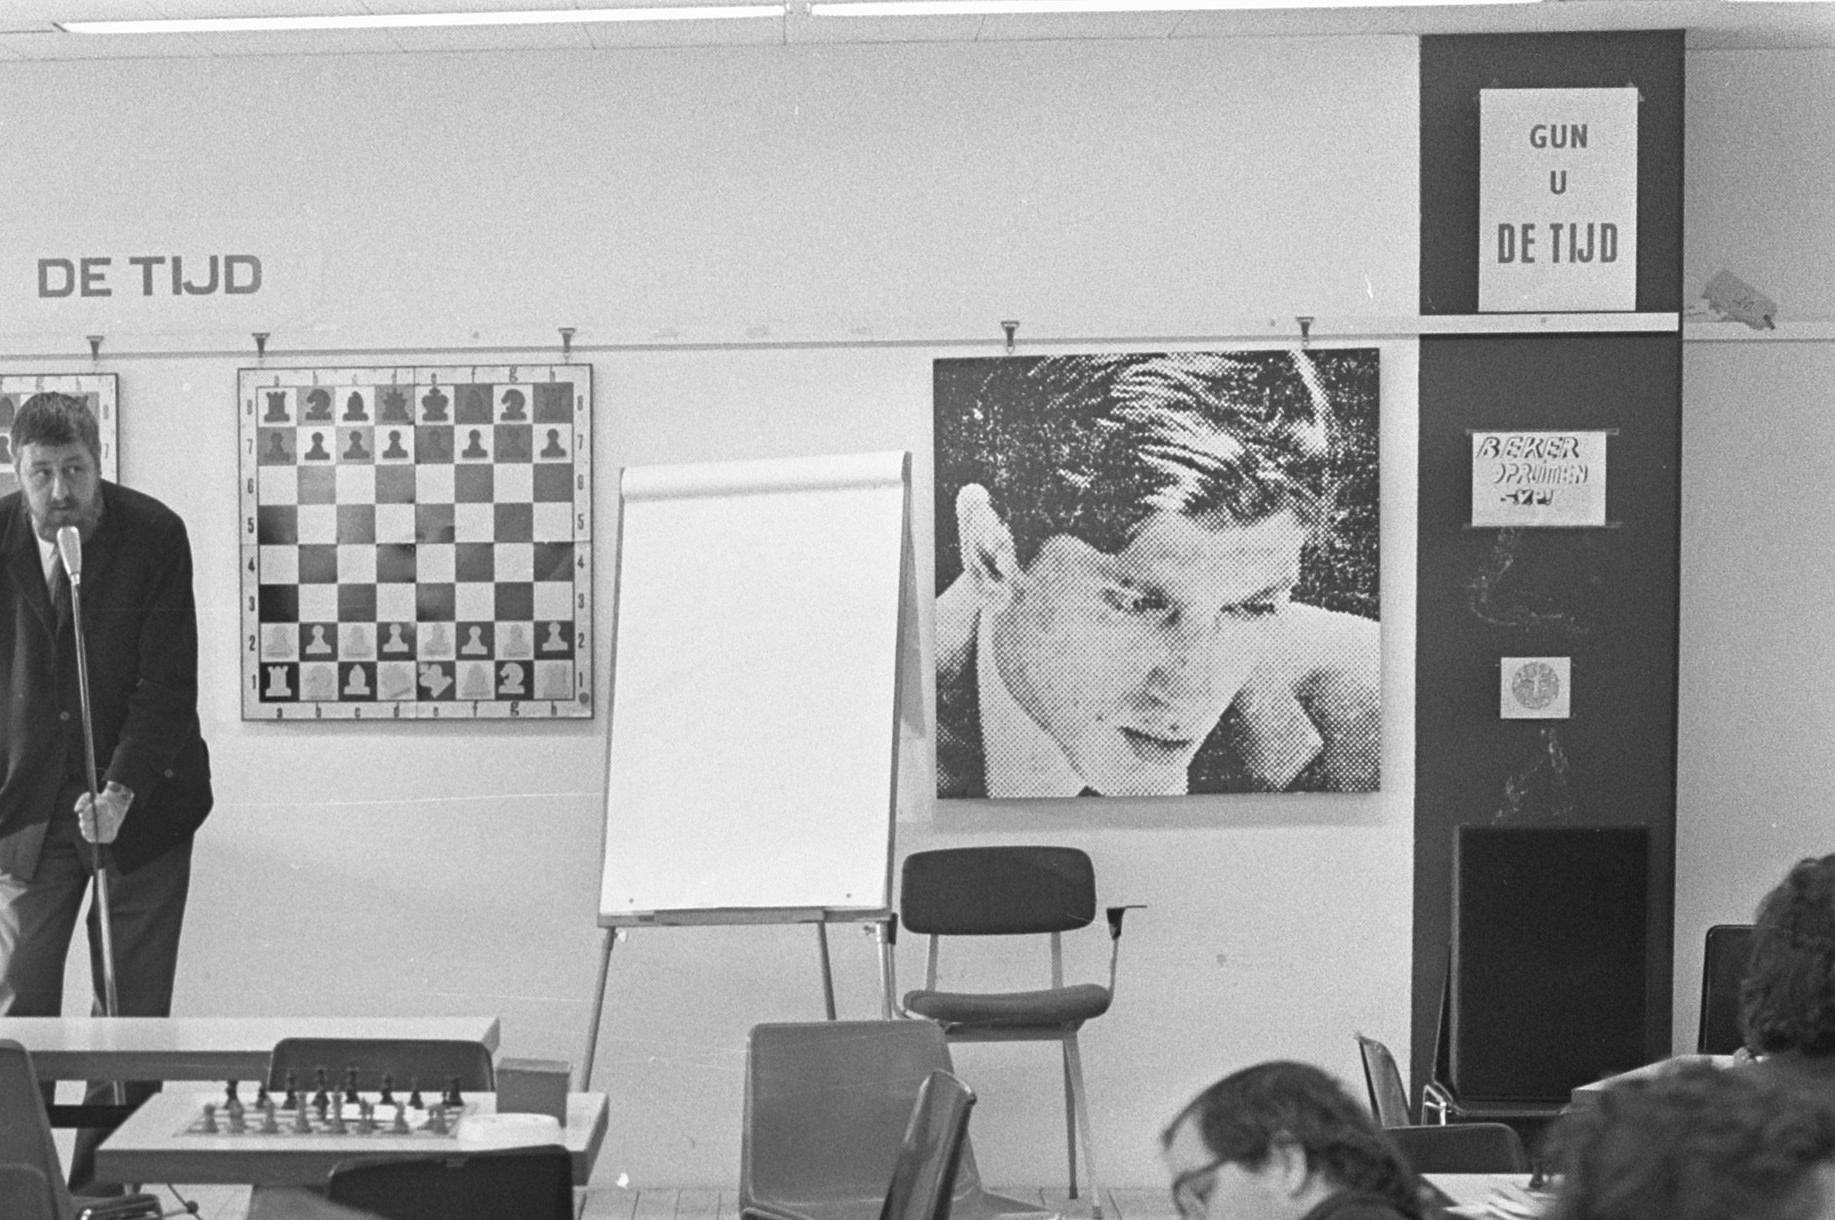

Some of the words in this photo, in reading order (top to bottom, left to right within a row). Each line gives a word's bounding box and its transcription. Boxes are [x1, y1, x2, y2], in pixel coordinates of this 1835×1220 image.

[1529, 123, 1589, 149] GUN
[1550, 170, 1567, 195] U
[1497, 222, 1536, 264] DE
[1549, 222, 1619, 264] TIJD
[37, 256, 113, 299] DE
[128, 254, 263, 297] TIJD
[509, 366, 518, 382] g
[247, 438, 253, 454] 7
[577, 434, 584, 450] 7
[1476, 436, 1580, 459] BEKER
[247, 478, 254, 494] 6
[247, 517, 254, 533] 5
[577, 513, 585, 530] 5
[247, 556, 256, 573] 4
[577, 554, 585, 569] 4
[248, 595, 256, 612] 3
[248, 635, 256, 651] 2
[578, 632, 585, 649] 2
[355, 707, 361, 718] c
[394, 702, 400, 718] d
[510, 701, 520, 717] g
[551, 701, 558, 716] h
